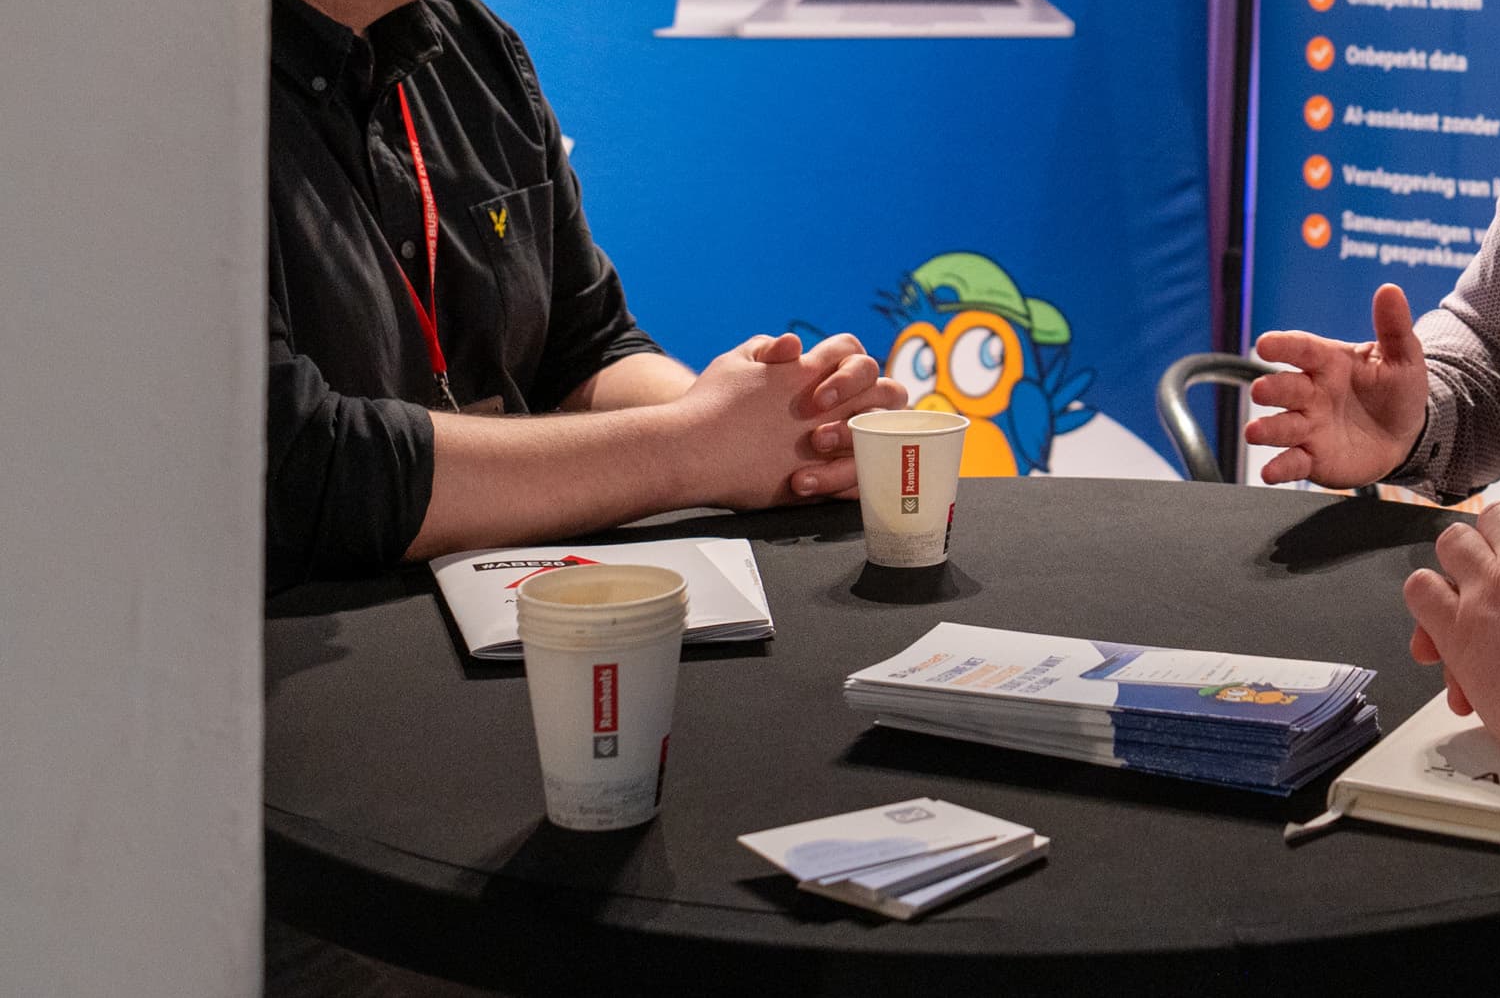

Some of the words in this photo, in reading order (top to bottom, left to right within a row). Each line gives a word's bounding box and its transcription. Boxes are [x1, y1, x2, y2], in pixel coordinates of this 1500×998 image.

[1345, 44, 1427, 72] Onbeperkt
[1429, 49, 1468, 72] data
[1343, 105, 1439, 131] AI-assistent
[1442, 114, 1500, 136] zonder
[1342, 164, 1456, 199] Verslaggeving
[1458, 179, 1491, 198] van
[422, 178, 437, 238] BUSINESS
[1341, 209, 1472, 245] Samenvattingen
[1340, 234, 1377, 260] jouw
[905, 448, 916, 492] Rombouts
